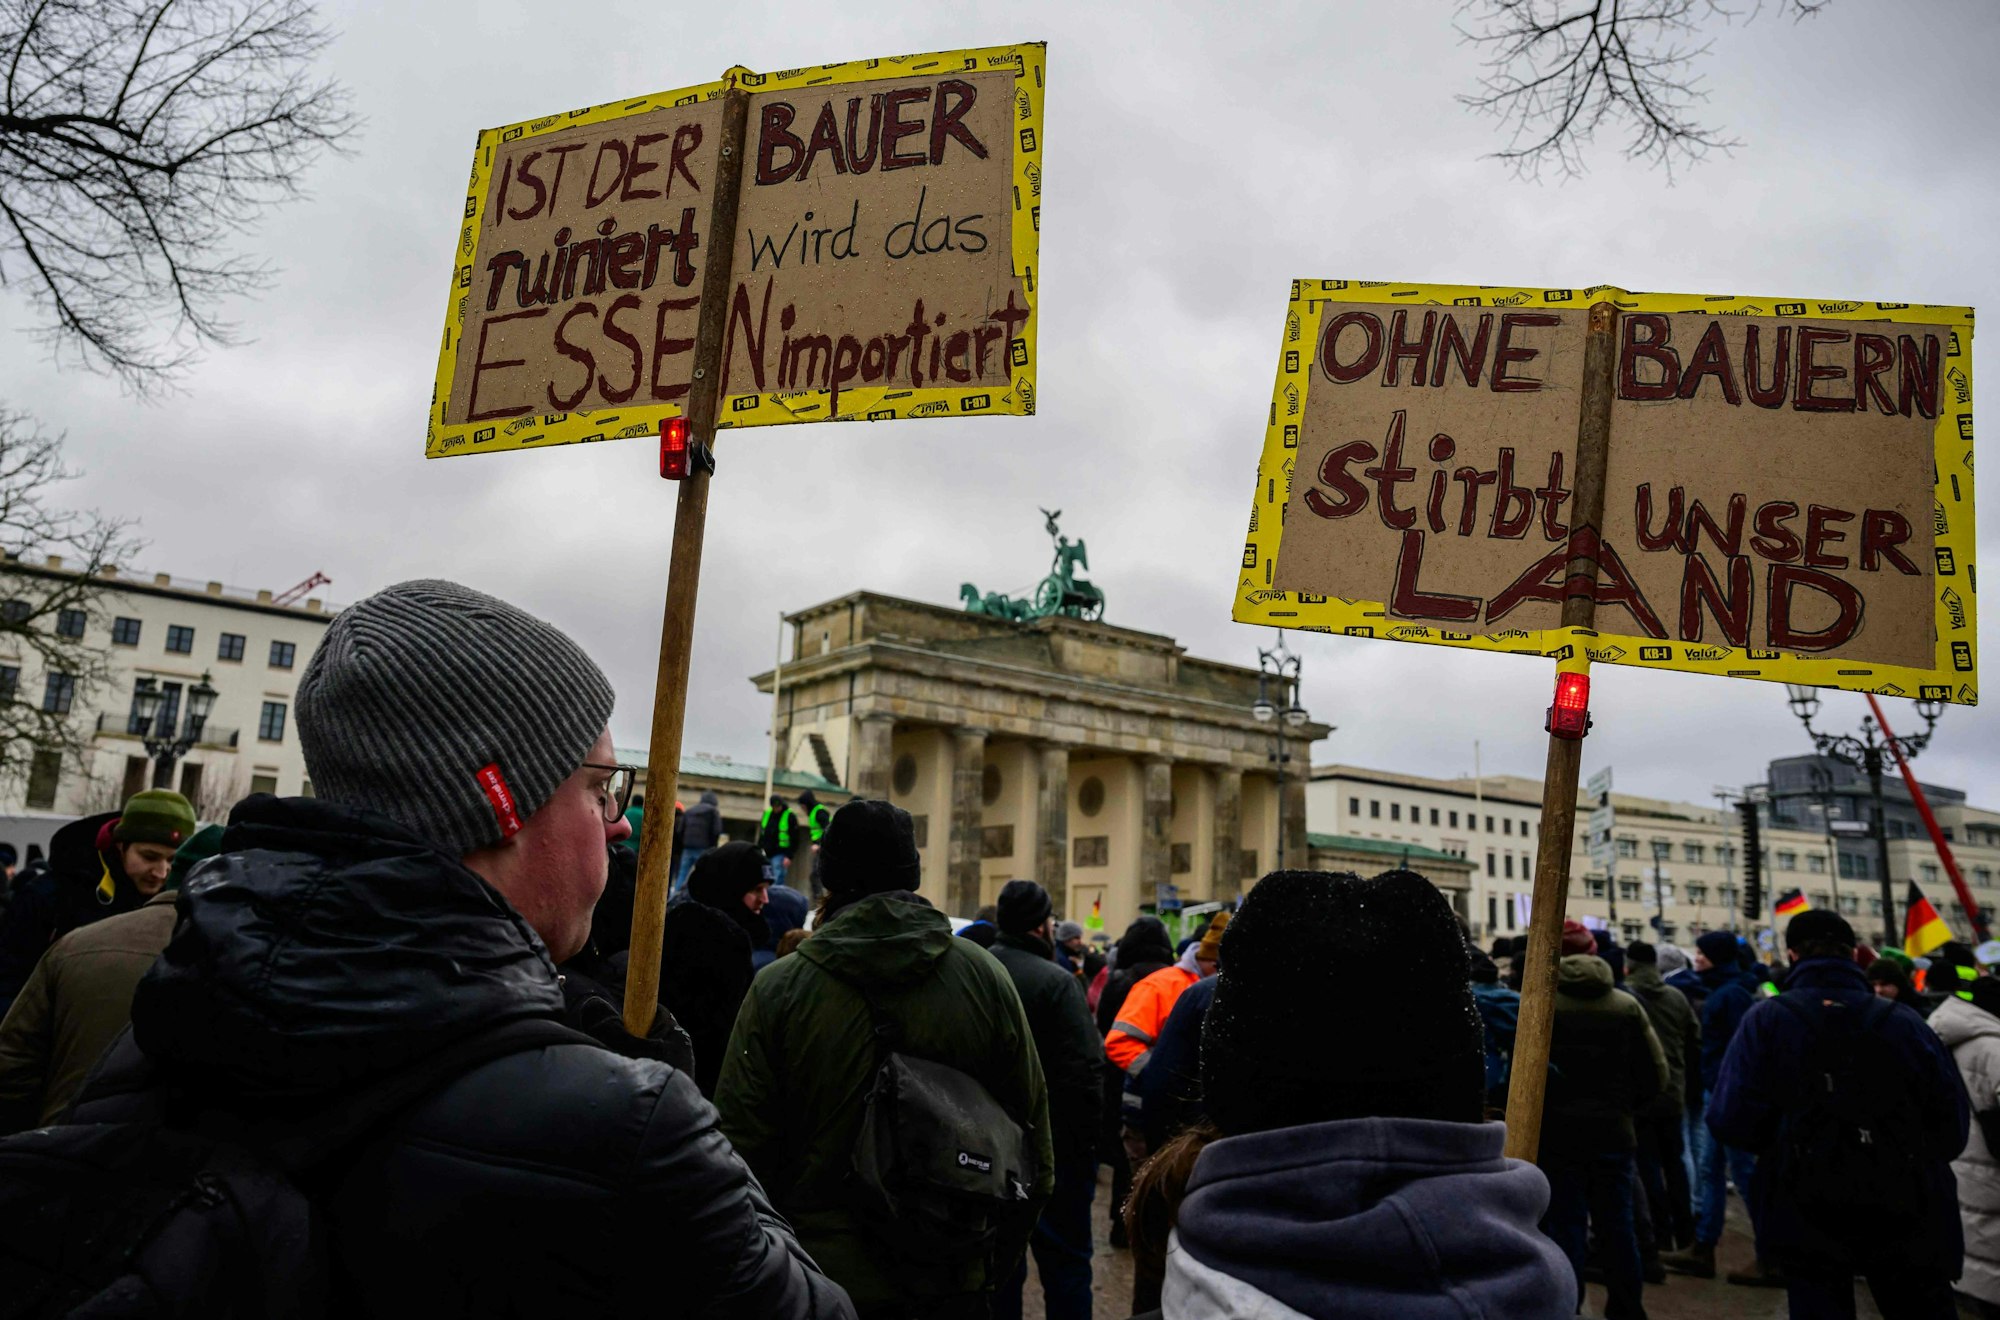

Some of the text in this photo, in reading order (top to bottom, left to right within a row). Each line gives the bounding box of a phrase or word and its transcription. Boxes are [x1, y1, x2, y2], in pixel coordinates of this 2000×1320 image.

[987, 55, 1014, 64] Valut
[1019, 98, 1029, 120] Valut
[496, 79, 989, 227] IST DER BAUER
[1030, 173, 1040, 197] Valut
[487, 186, 988, 309] ruiniert wird das
[1492, 297, 1519, 306] Valut
[1818, 303, 1850, 312] Valut
[1288, 320, 1297, 342] Valut
[1322, 310, 1943, 419] OHNE BAUERN
[1955, 379, 1967, 404] Valut
[1287, 393, 1297, 416] Valut
[1304, 409, 1922, 576] stirbt UNSER
[1259, 592, 1287, 601] Valut
[1390, 527, 1864, 652] LAND
[1948, 602, 1961, 629] Valut
[1400, 629, 1429, 638] Valut
[1684, 649, 1717, 658] Valut
